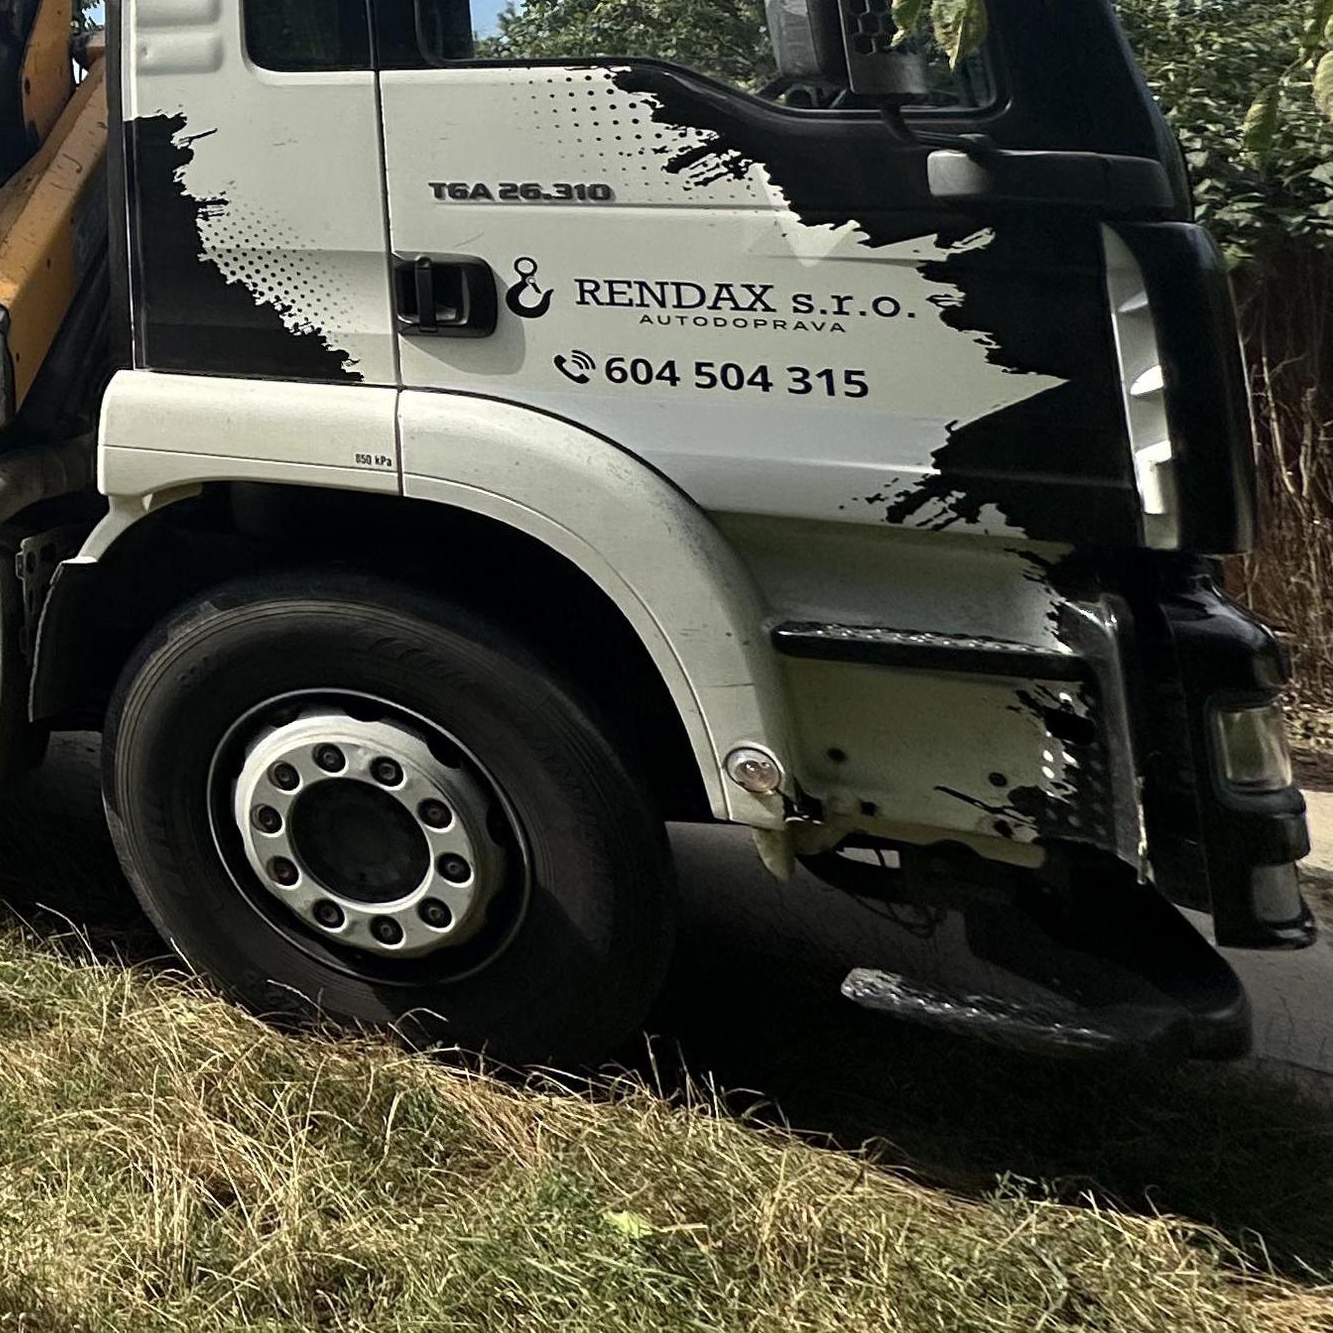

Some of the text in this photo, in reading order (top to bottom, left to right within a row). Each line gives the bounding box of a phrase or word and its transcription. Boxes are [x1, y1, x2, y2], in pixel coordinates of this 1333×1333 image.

[428, 182, 613, 202] TGA 26.310
[574, 278, 916, 318] RENDAX s.r.o.
[639, 314, 846, 333] AUTODOPRAVA
[605, 357, 870, 398] 604 504 315
[355, 453, 392, 467] 850 kPa
